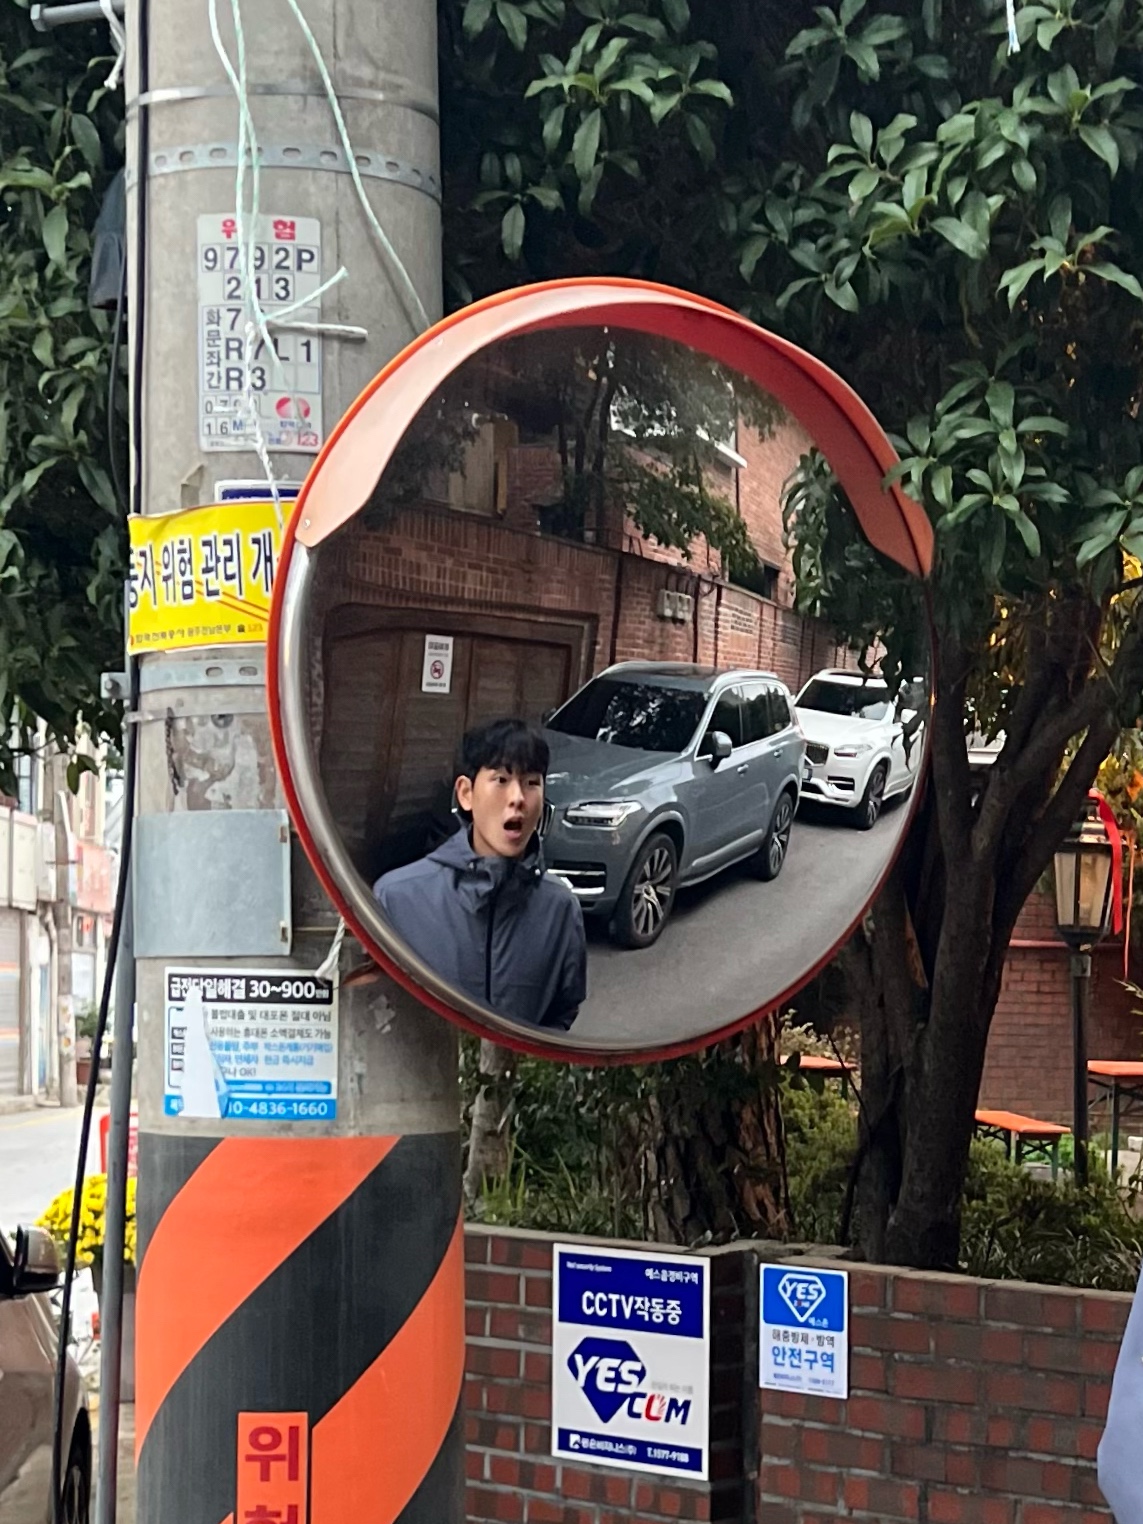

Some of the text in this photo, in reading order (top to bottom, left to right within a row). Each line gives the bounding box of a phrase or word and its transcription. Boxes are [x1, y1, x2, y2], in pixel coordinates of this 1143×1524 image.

[226, 276, 291, 302] 213
[225, 366, 267, 391] R3
[162, 537, 195, 603] 위험
[201, 532, 243, 598] 관리
[785, 1280, 821, 1301] YES
[582, 1290, 682, 1325] CCTV작동중
[771, 1345, 835, 1373] 안전구역
[574, 1354, 643, 1394] YES
